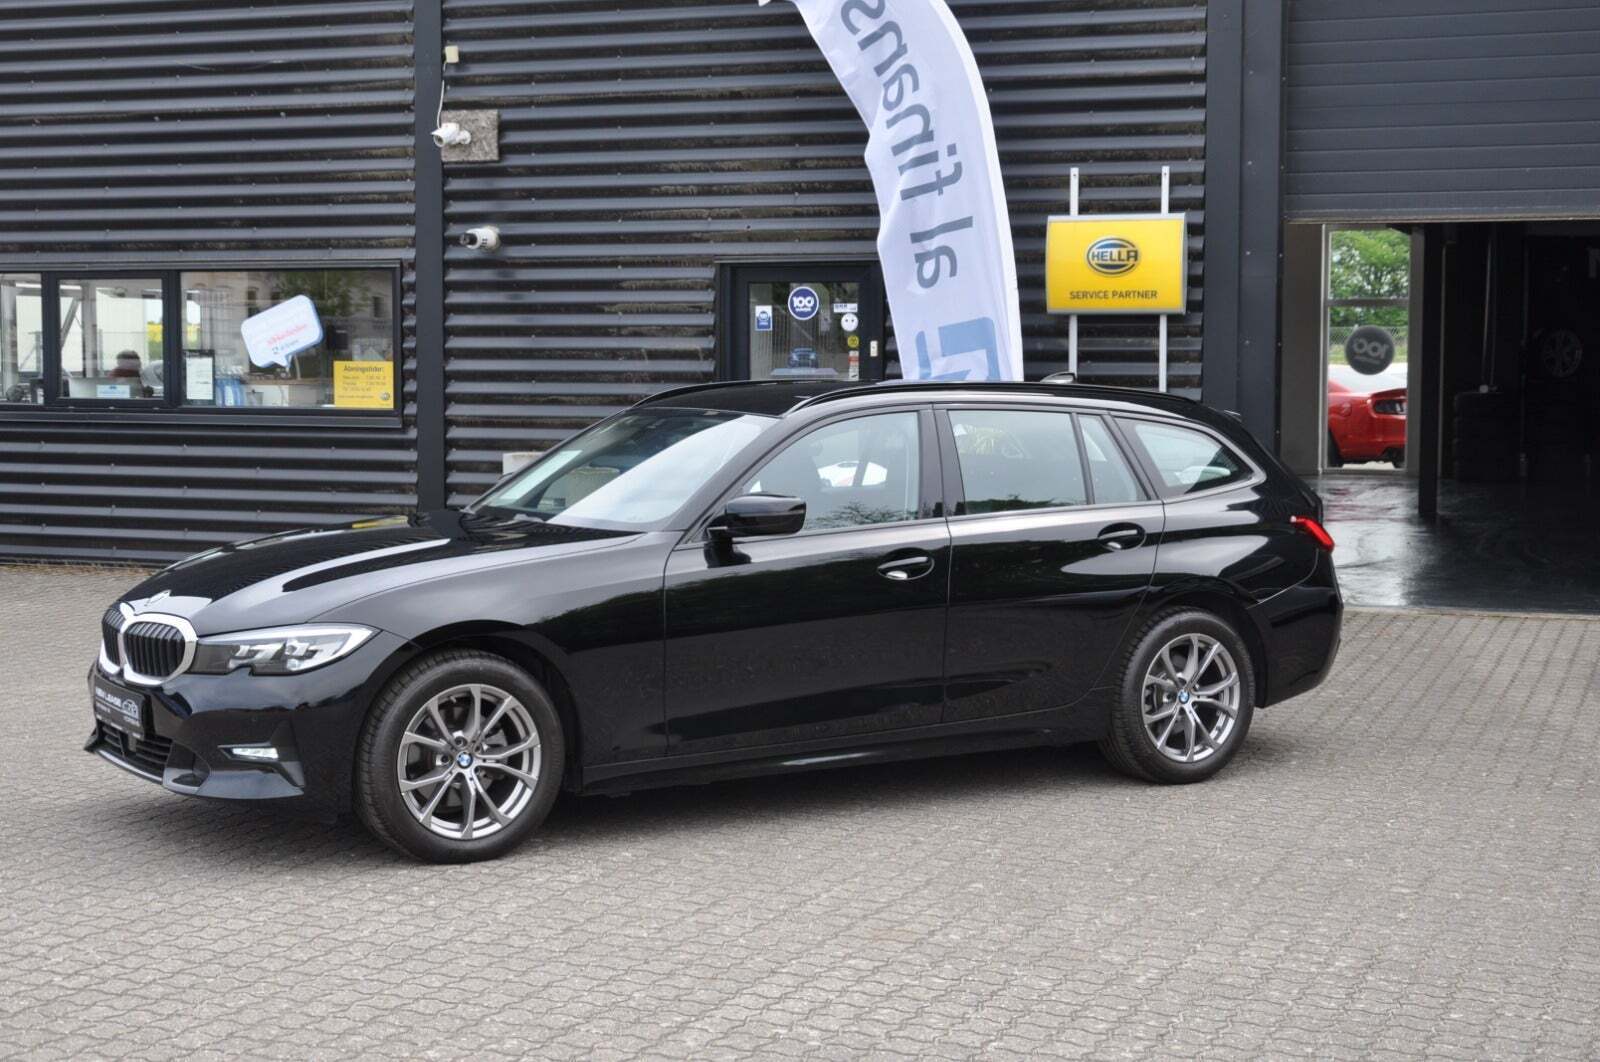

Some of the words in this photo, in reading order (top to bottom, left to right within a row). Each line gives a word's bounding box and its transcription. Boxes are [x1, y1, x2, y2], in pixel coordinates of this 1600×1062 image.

[1091, 249, 1138, 262] HELLA
[1069, 290, 1109, 300] SERVICE
[1111, 289, 1158, 300] PARTNER
[792, 296, 815, 308] 100
